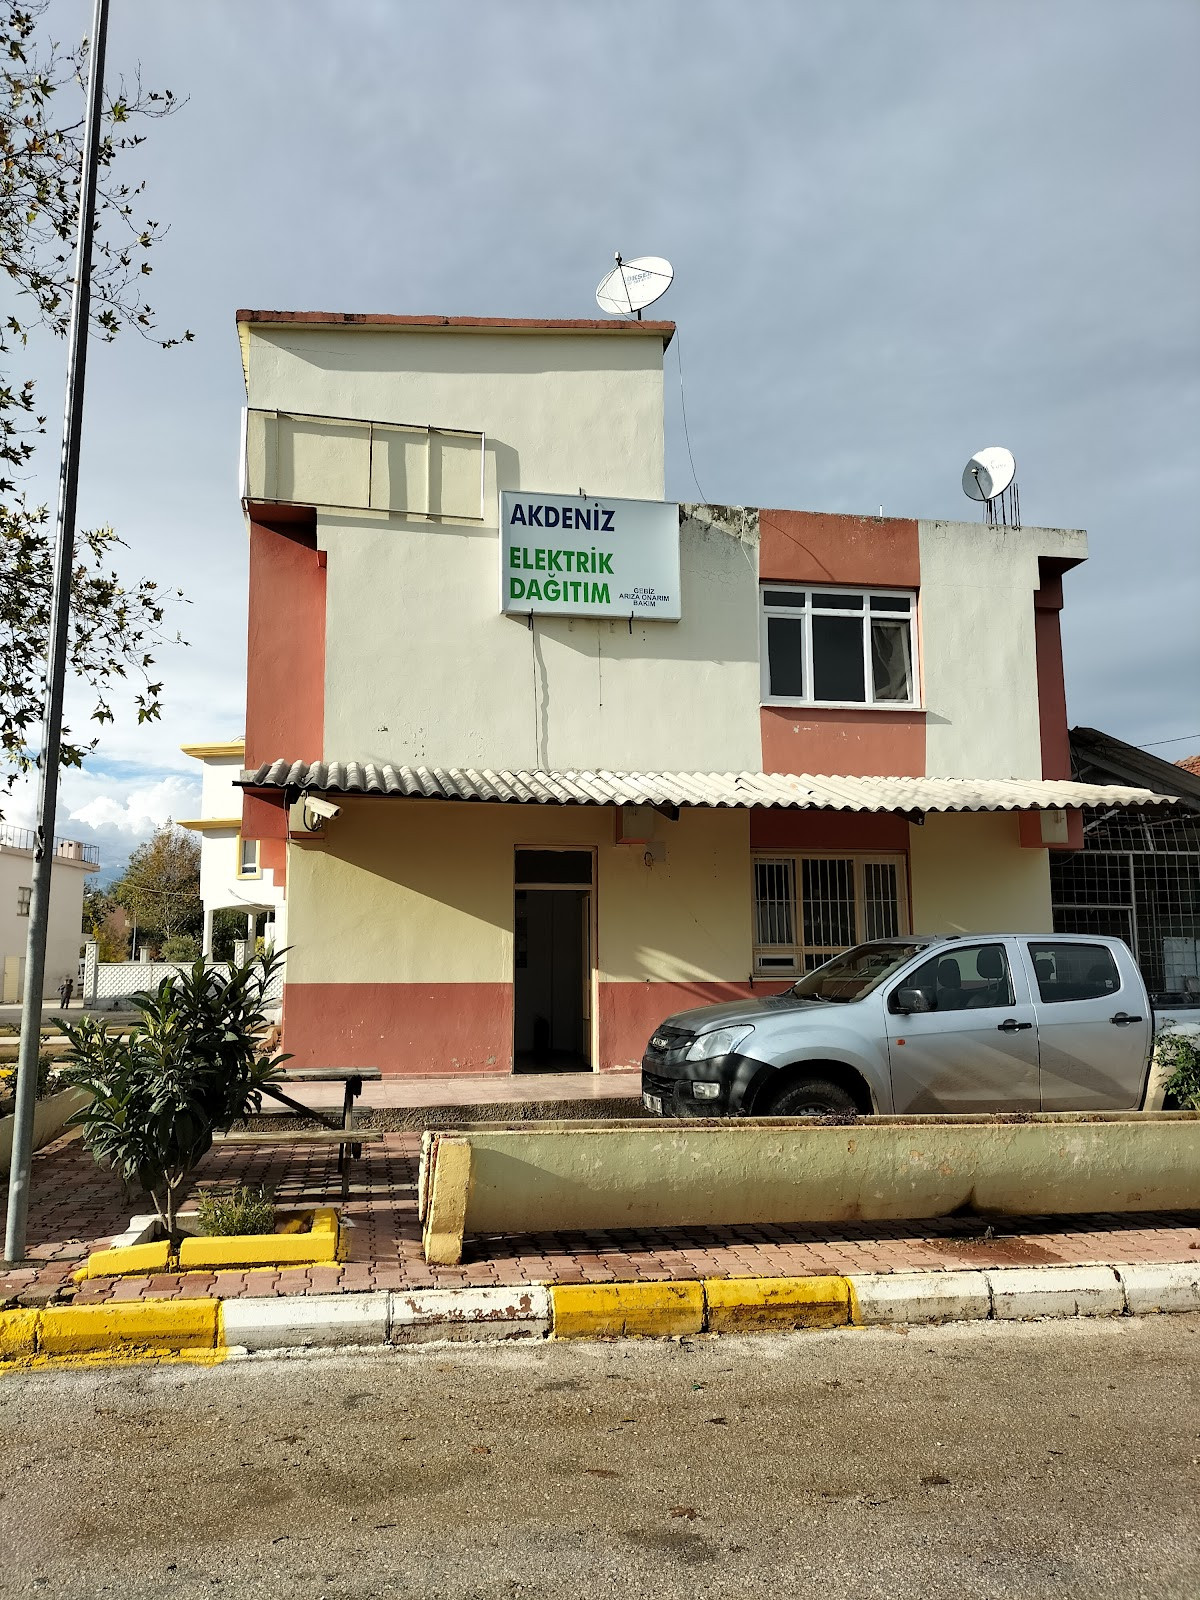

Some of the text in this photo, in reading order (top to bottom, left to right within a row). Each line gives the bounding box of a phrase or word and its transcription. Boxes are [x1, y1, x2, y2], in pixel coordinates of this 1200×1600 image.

[510, 503, 616, 532] AKDENİZ
[510, 546, 615, 575] ELEKTRİK
[510, 573, 611, 604] DAĞITIM
[633, 587, 655, 595] GEBİZ
[641, 594, 670, 602] ONARIM
